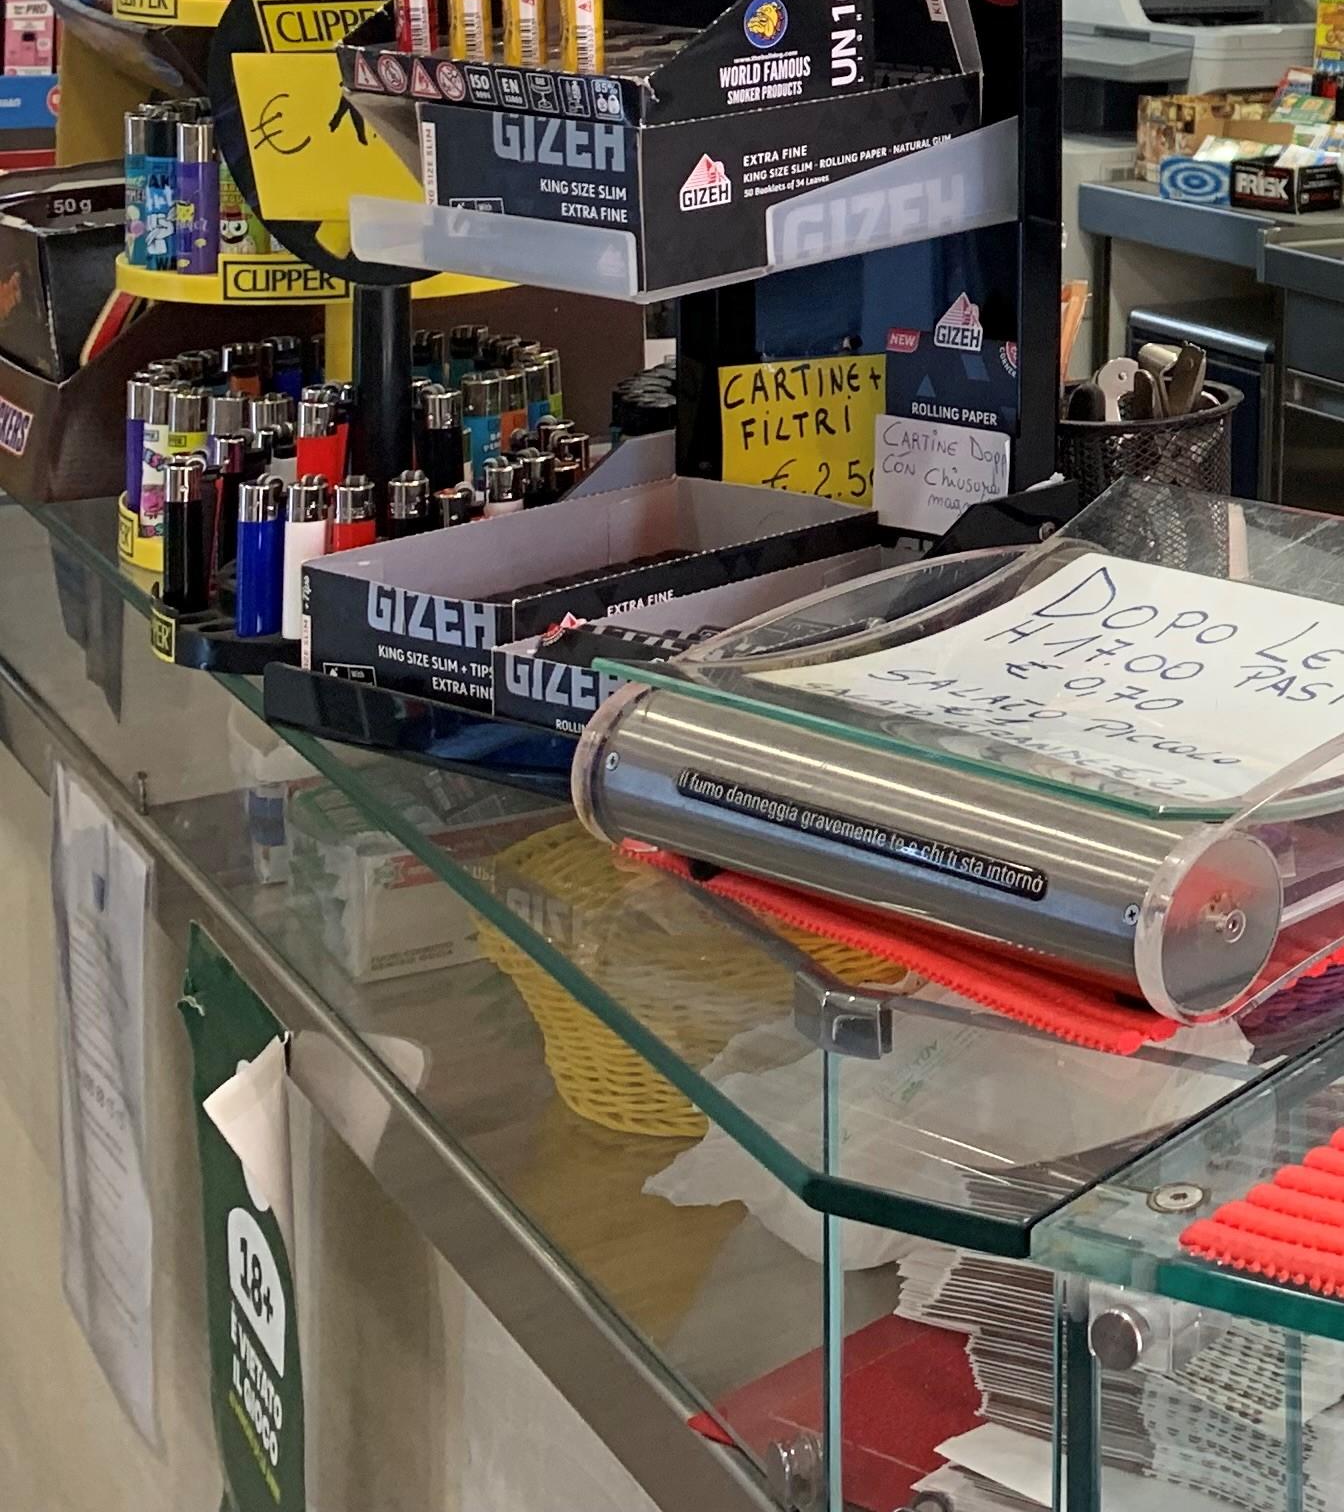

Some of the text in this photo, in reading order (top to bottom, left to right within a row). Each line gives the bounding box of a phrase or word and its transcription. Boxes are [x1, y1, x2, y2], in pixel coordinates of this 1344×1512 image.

[276, 8, 374, 43] CLIPP
[832, 18, 857, 86] UN
[469, 73, 490, 90] ISO
[719, 56, 811, 89] WORLD FAMOUS
[501, 78, 520, 94] EN
[727, 81, 803, 105] SMOKER PRODUCTS
[492, 111, 625, 173] GIZEH
[743, 144, 808, 168] EXTRA FINE
[540, 178, 627, 201] KING SIZE SLIM
[1235, 168, 1289, 199] FRISK
[683, 184, 730, 209] GIZEH
[561, 202, 628, 224] EXTRA FINE
[233, 269, 335, 291] CLIPPER
[890, 333, 915, 347] NEW
[723, 362, 861, 409] CARTINE
[911, 402, 998, 426] ROLLING PAPER
[1032, 566, 1238, 645] DOPO
[984, 620, 1042, 645] H
[868, 667, 1242, 766] SALATO PICCOLO
[690, 773, 723, 800] fumo
[726, 786, 798, 821] danneggia
[801, 810, 886, 848] gravemente
[890, 834, 905, 852] te
[920, 841, 945, 866] chi
[947, 845, 960, 869] ti
[961, 854, 983, 877] sta
[986, 861, 1043, 893] intorno
[240, 1237, 273, 1324] 18+
